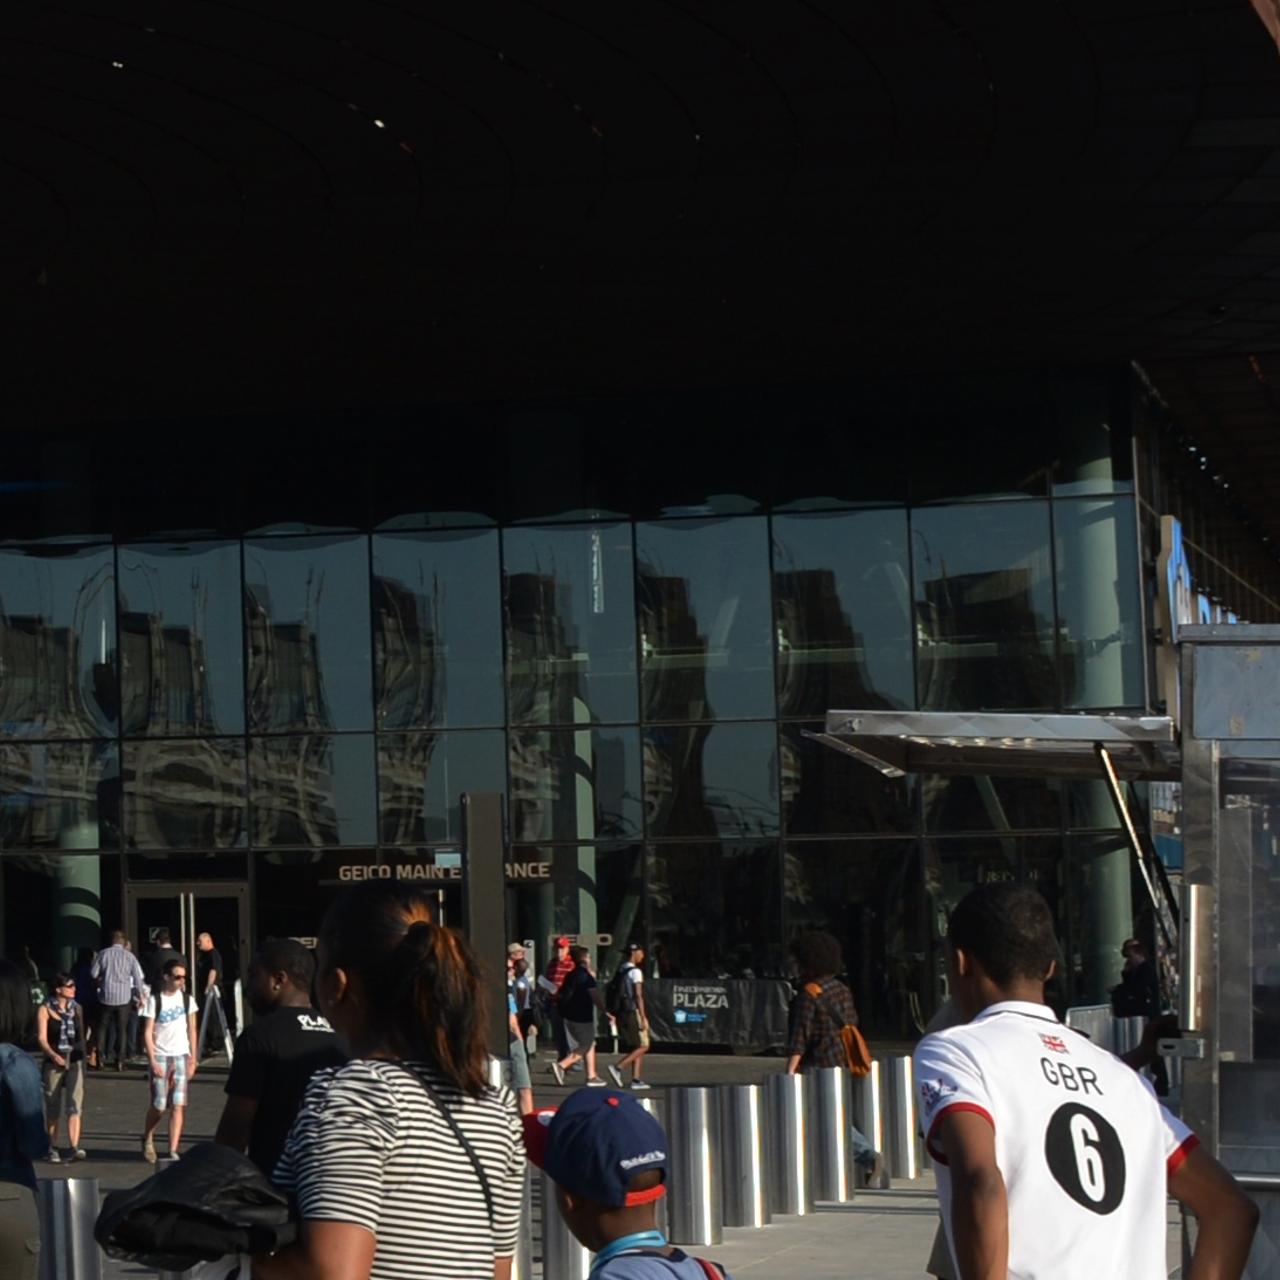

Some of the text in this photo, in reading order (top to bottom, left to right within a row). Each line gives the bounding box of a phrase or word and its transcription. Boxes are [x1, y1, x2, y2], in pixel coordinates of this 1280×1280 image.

[339, 864, 391, 881] GEICO
[396, 864, 444, 879] MAIN
[672, 993, 730, 1009] PLAZA
[1039, 1056, 1104, 1097] GBR
[1069, 1112, 1106, 1203] 6
